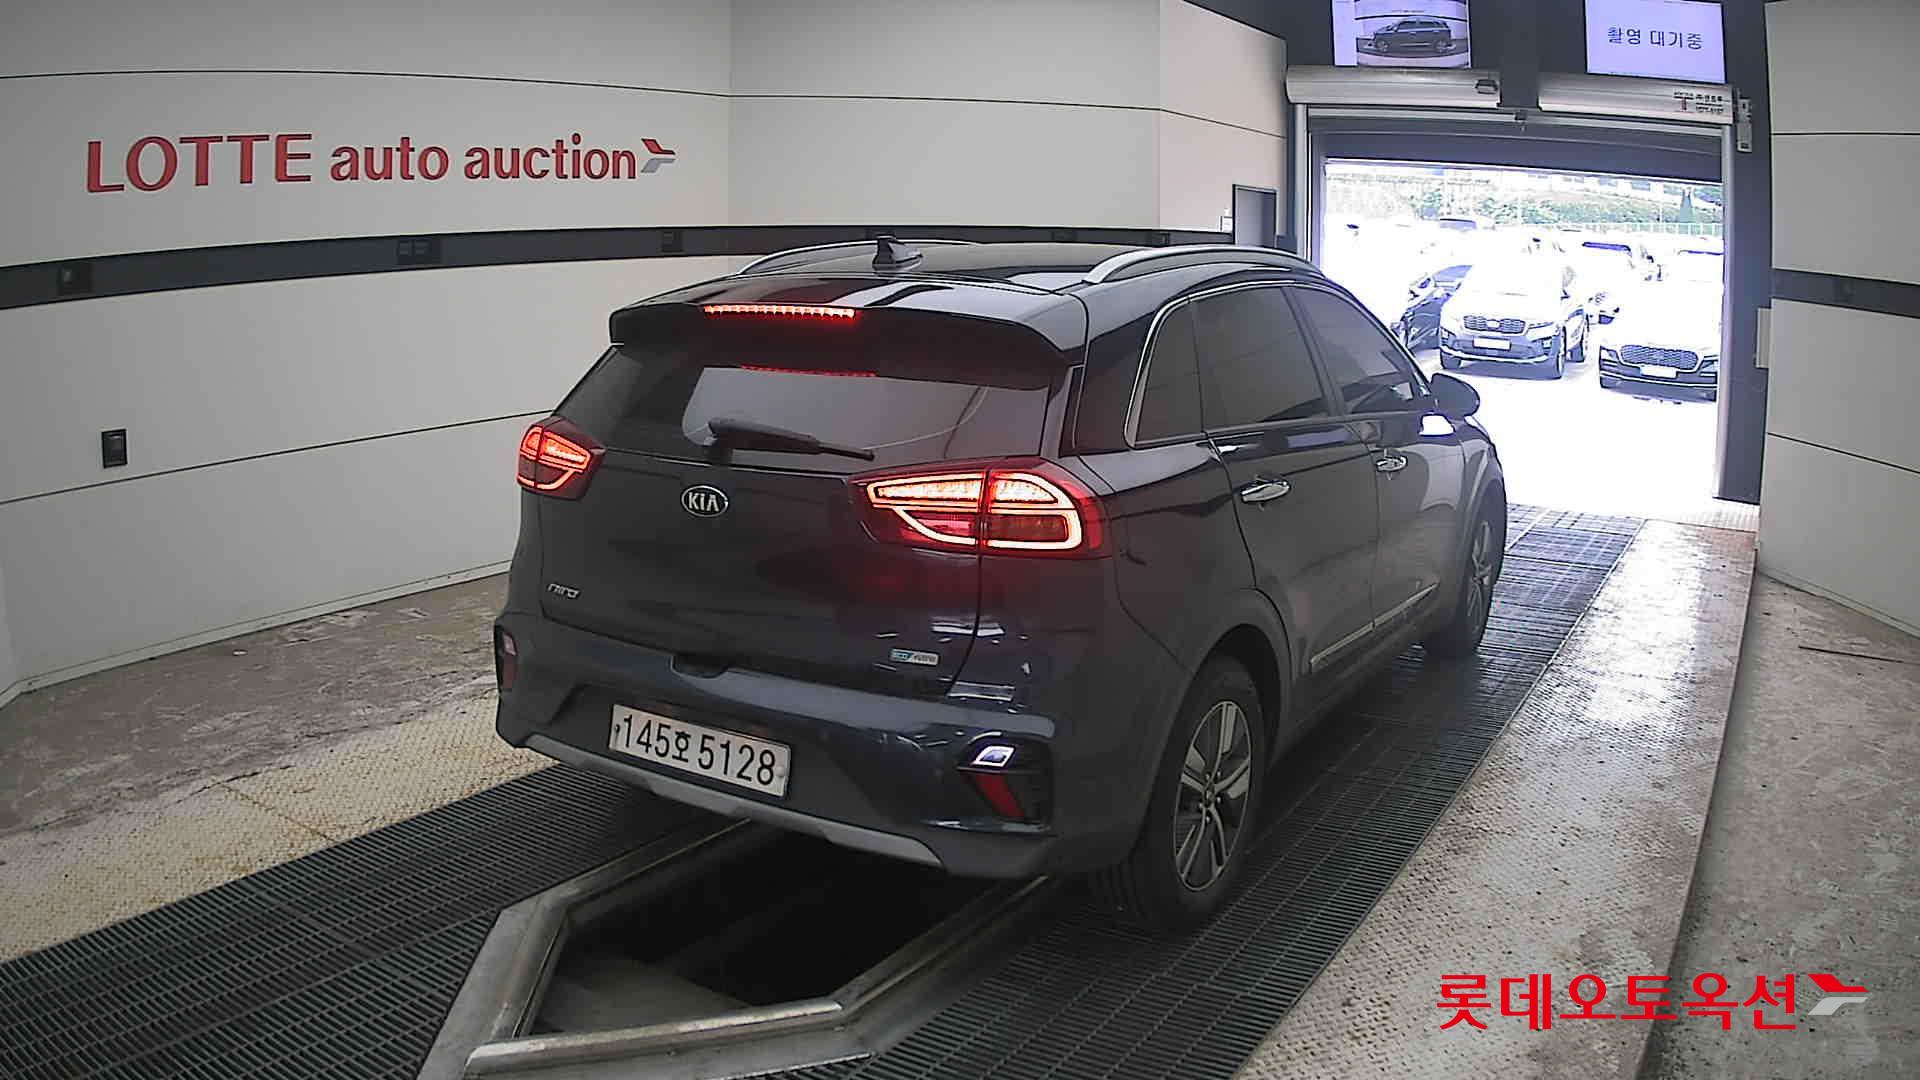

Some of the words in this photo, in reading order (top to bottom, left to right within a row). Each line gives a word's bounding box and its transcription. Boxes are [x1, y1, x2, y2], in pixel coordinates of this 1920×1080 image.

[1649, 30, 1703, 50] 대기중
[86, 133, 312, 194] LOTTE
[329, 136, 450, 181] auto
[463, 132, 637, 180] auction
[687, 492, 720, 512] KIA
